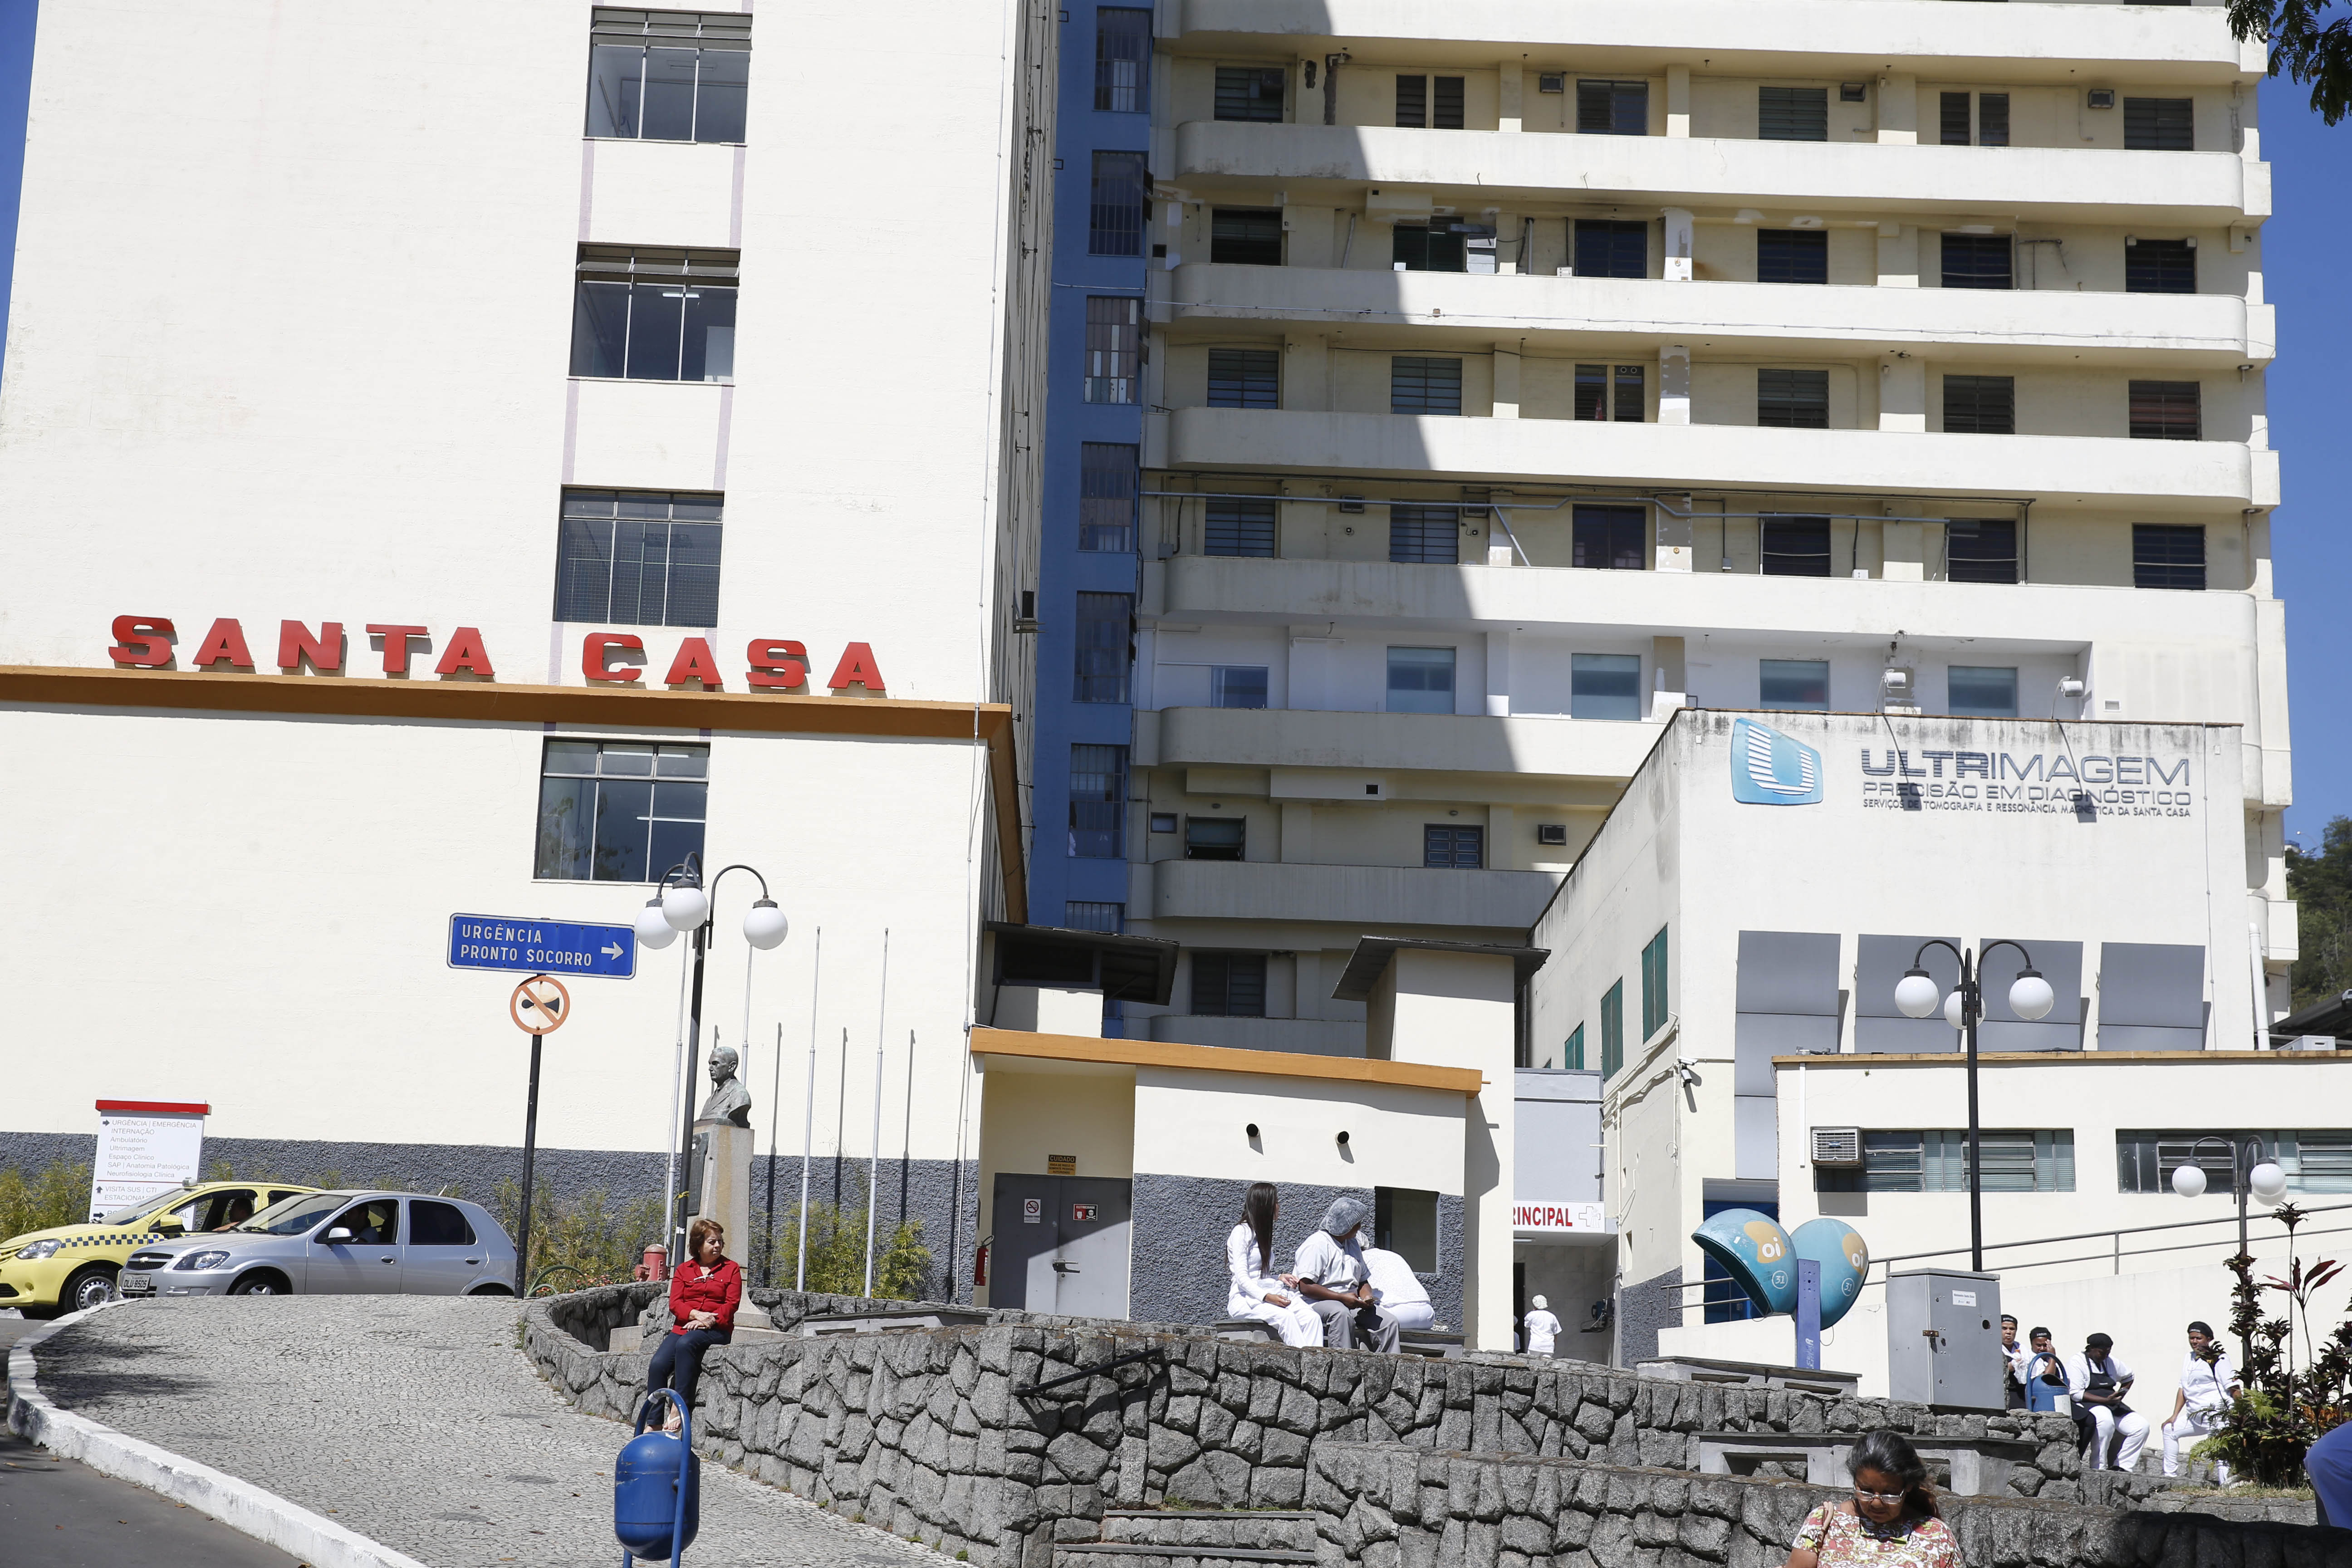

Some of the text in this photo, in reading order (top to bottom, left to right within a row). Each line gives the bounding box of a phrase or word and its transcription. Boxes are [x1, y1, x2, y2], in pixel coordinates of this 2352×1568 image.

[108, 615, 886, 690] SANTA CASA
[1862, 749, 2189, 786] ULTRIMAGEM
[1863, 781, 2191, 805] PRECISÃO EM DIAGNÓSTICO
[1863, 799, 2191, 817] SERVIÇOS DE TOMOGRAFIA E RESSONÂNCIA MAGNÉTICA DA SANTA CASA
[462, 924, 542, 943] URGÊNCIA
[460, 945, 592, 966] PRONTO SOCORRO
[1775, 1275, 1785, 1284] 31
[1845, 1283, 1852, 1292] 31
